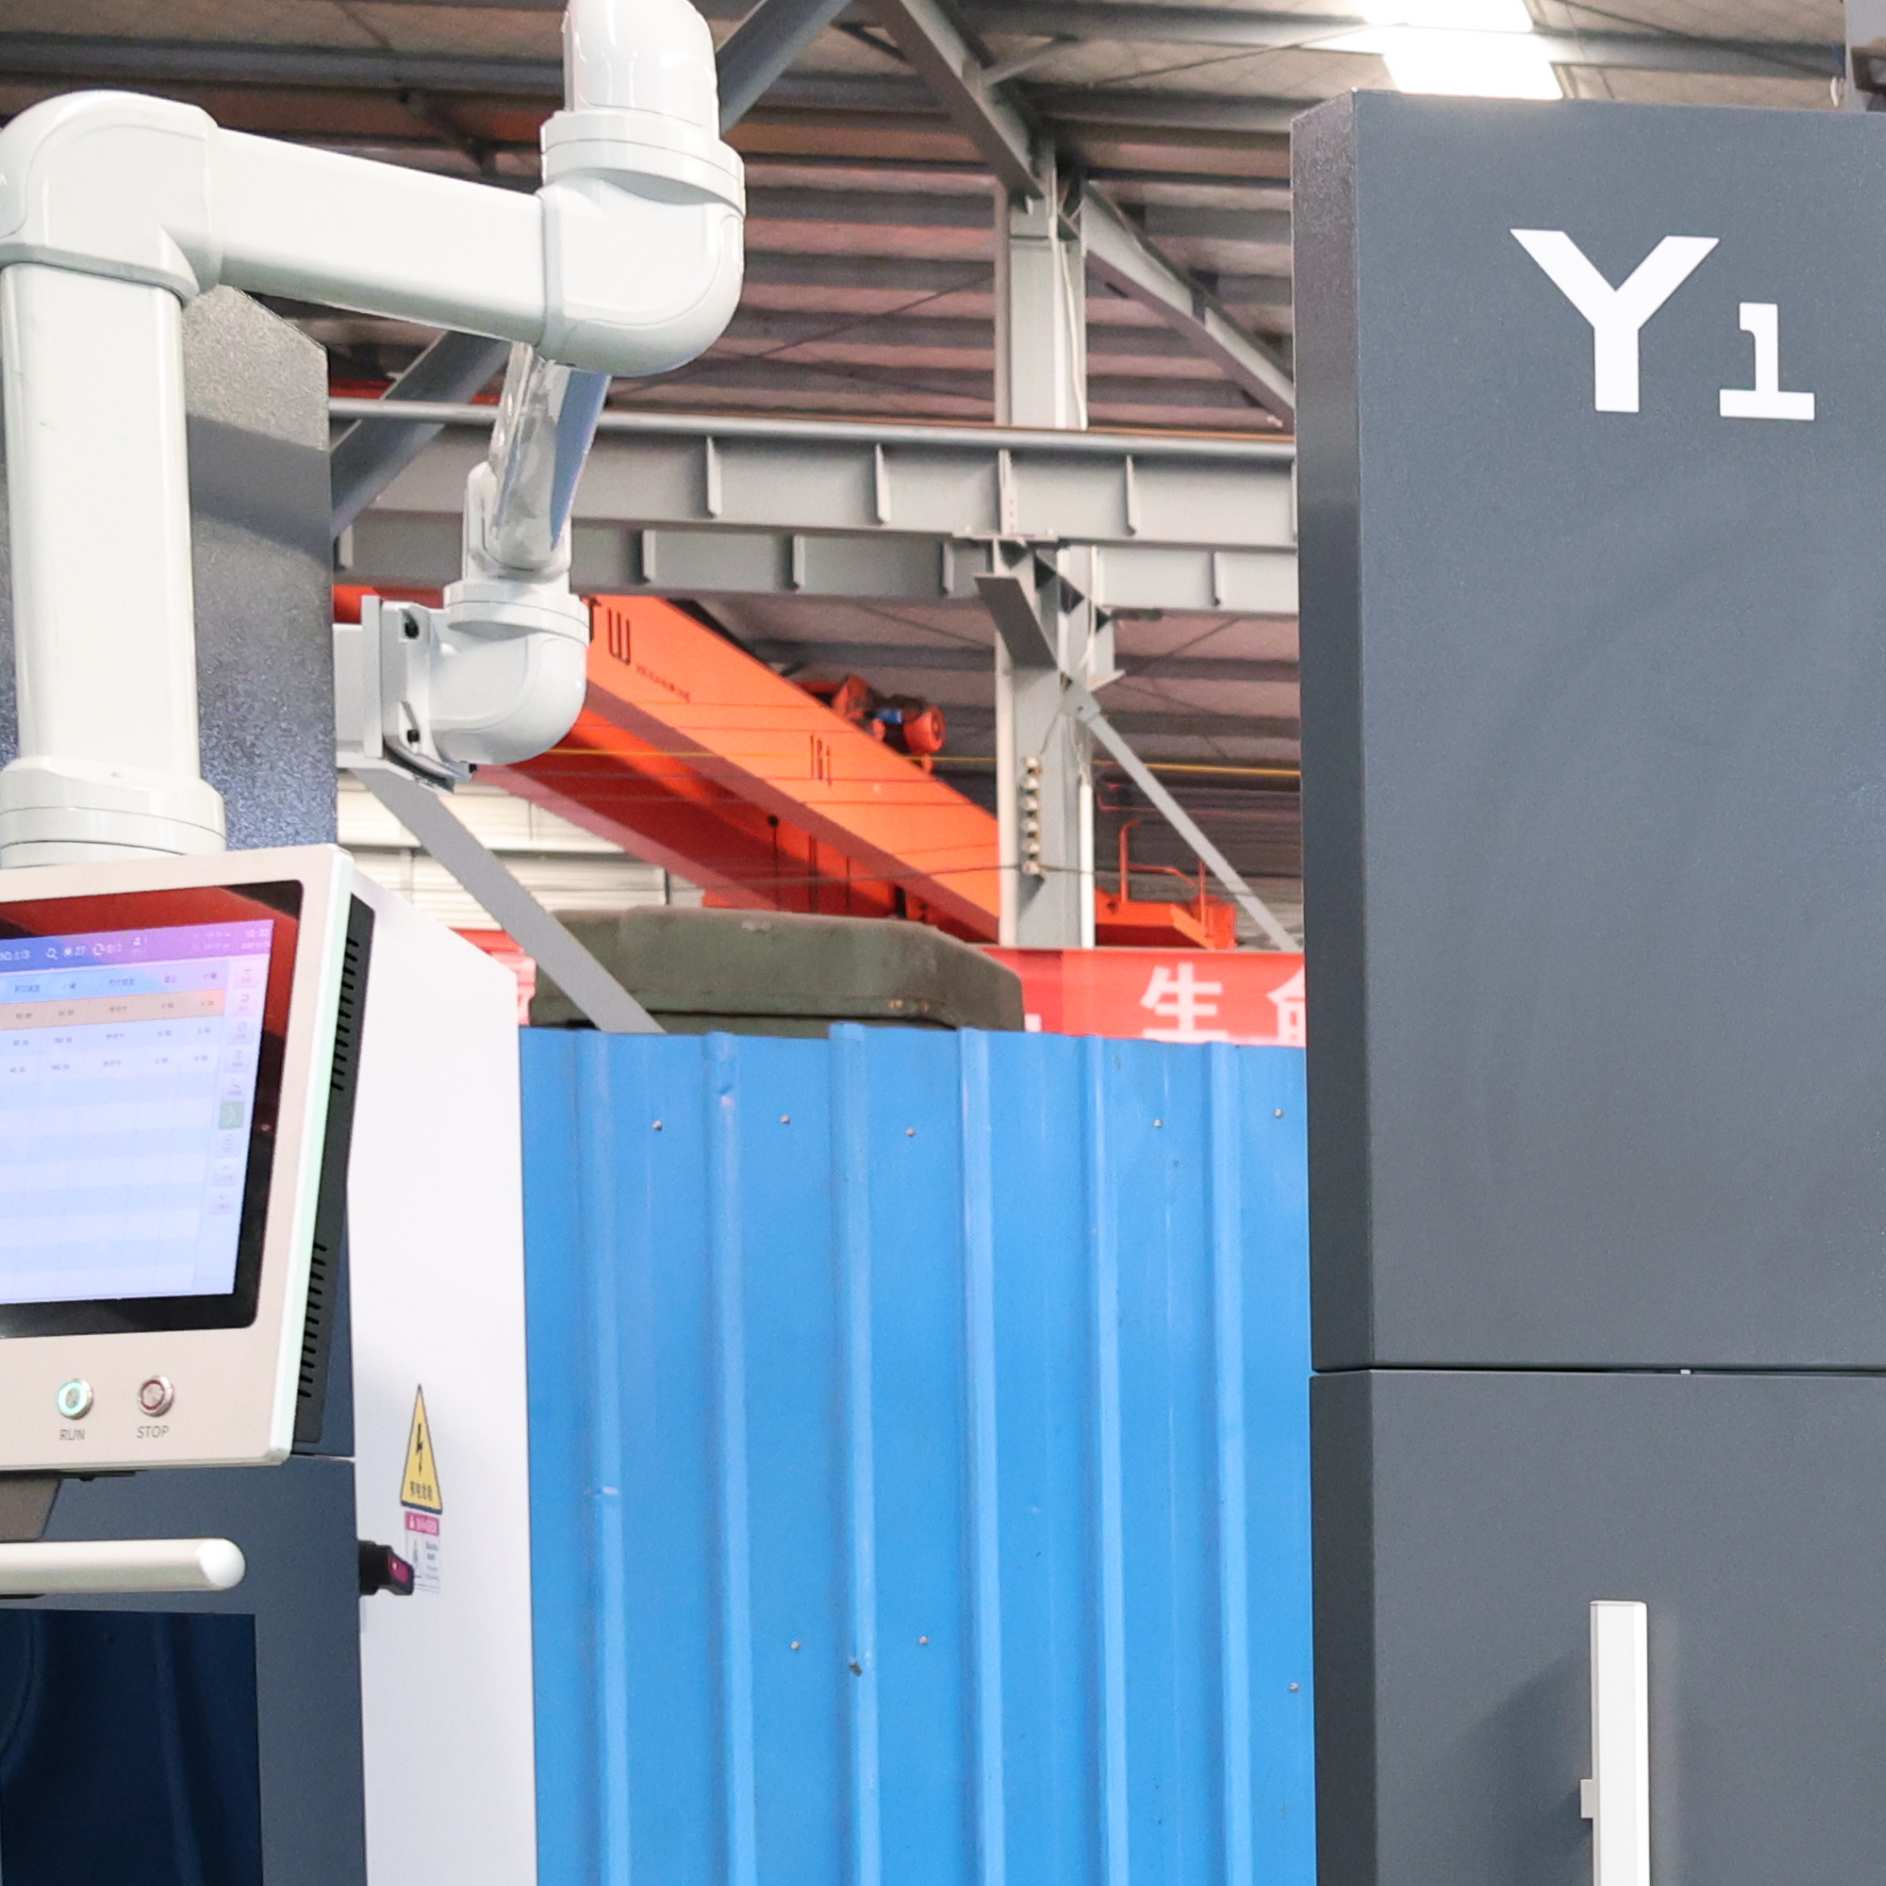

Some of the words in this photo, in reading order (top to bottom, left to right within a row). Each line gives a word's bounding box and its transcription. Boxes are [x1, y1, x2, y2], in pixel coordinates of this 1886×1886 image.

[1510, 228, 1815, 421] Y1
[59, 1428, 86, 1441] RUN
[136, 1425, 169, 1439] STOP
